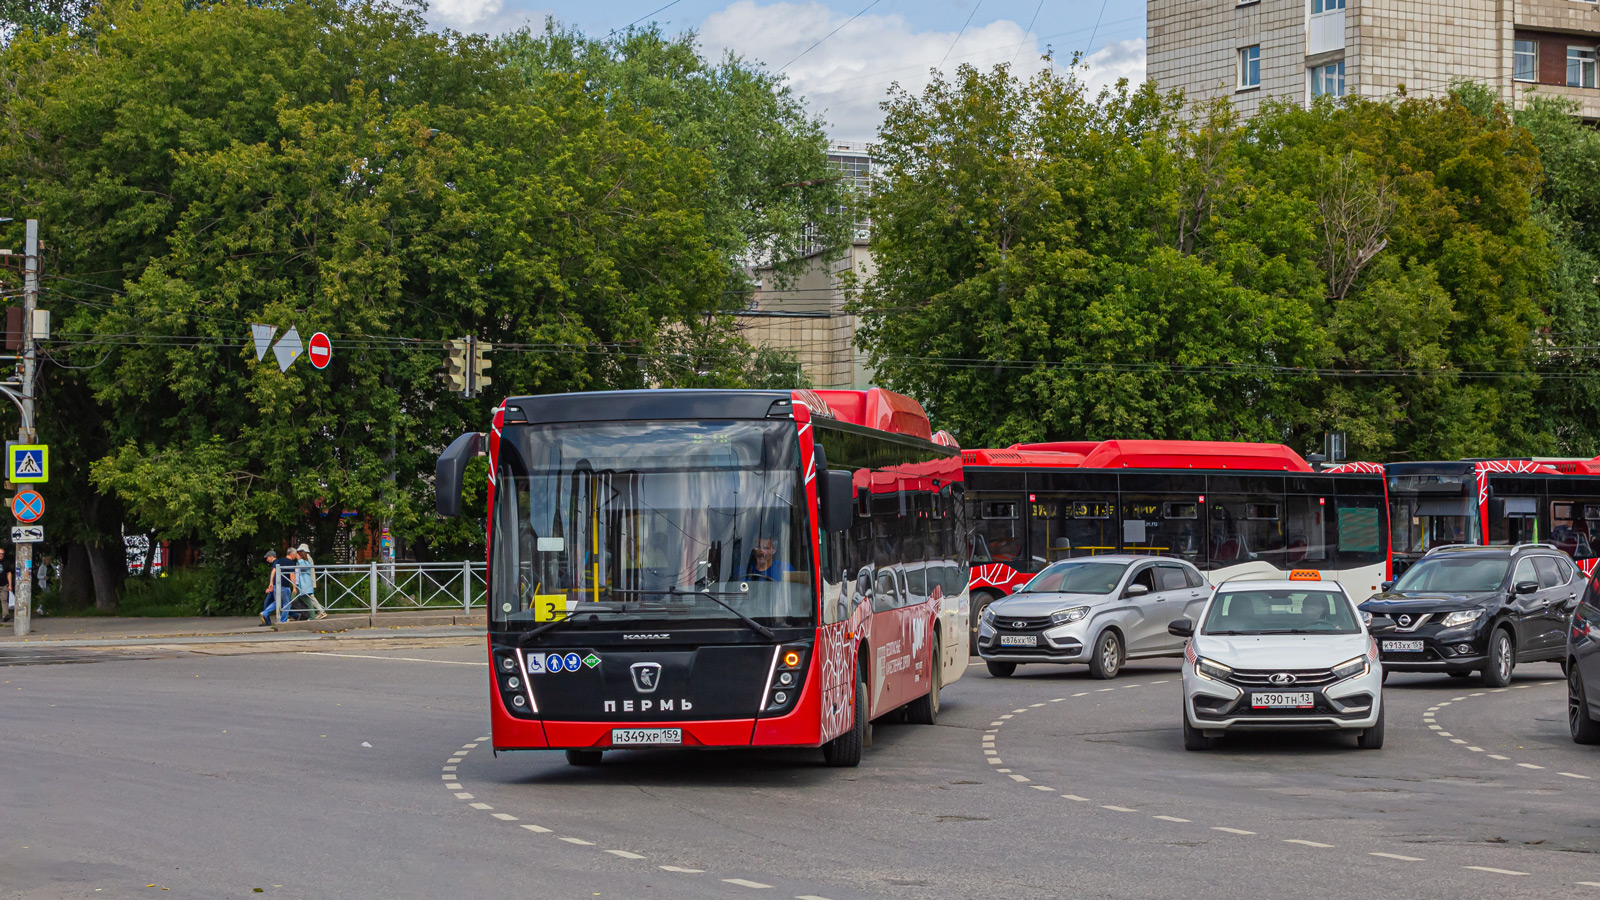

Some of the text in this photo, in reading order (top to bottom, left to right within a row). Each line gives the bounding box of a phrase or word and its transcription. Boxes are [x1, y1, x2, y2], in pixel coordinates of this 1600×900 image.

[545, 602, 556, 621] 3
[1255, 693, 1310, 704] М390ТН 13
[604, 699, 693, 713] ПЕРМЬ
[616, 729, 679, 742] Н349ХР 159
